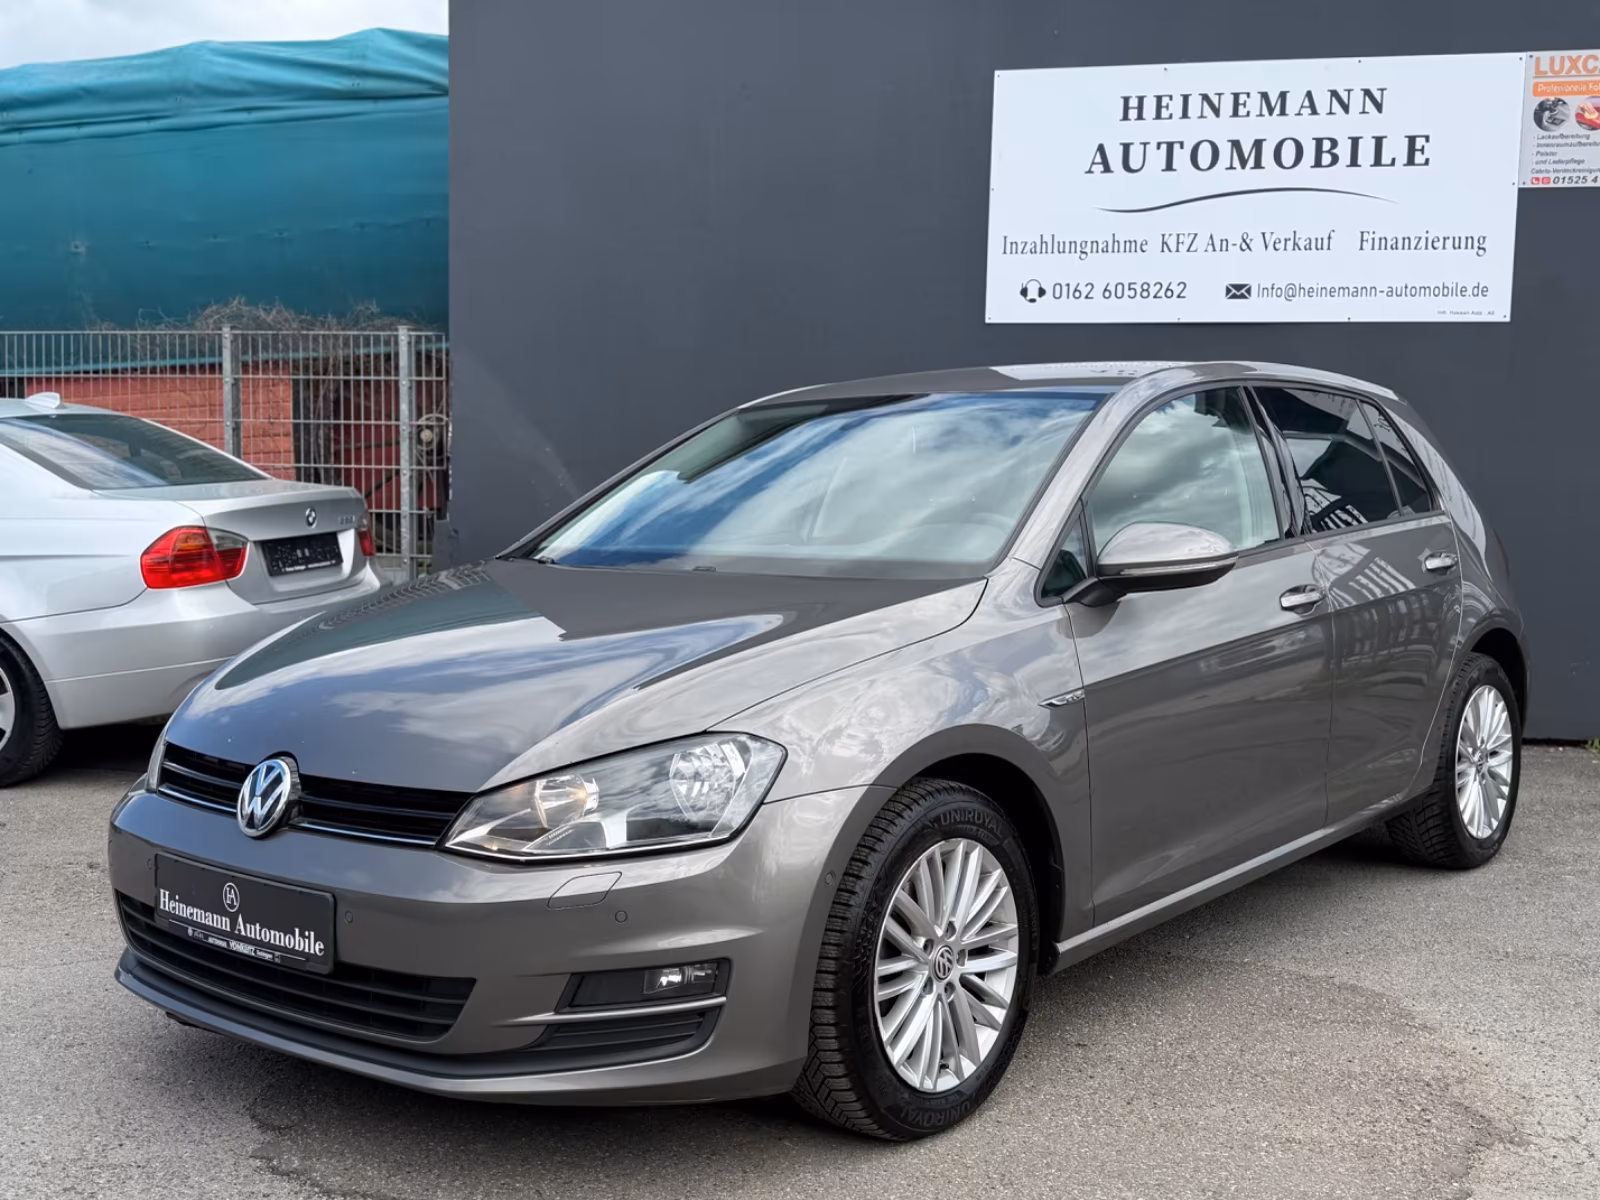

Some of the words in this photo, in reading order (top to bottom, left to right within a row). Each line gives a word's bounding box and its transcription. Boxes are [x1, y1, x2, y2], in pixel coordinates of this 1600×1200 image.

[1534, 55, 1600, 75] LUXC
[1119, 87, 1388, 122] HEINEMANN
[1084, 134, 1431, 174] AUTOMOBILE
[1548, 158, 1586, 166] Lederpflege
[1552, 175, 1588, 185] 01525
[1590, 175, 1599, 184] 4
[1002, 233, 1149, 261] Inzahlungnahme
[1160, 232, 1198, 253] KFZ
[1260, 230, 1335, 252] Verkauf
[1358, 230, 1488, 257] Finanzierung
[1052, 282, 1095, 300] 0162
[1102, 281, 1188, 300] 6058262
[1257, 281, 1489, 302] Info@heinemann-automobile.de
[159, 888, 231, 932] Heinemann
[234, 913, 325, 956] Automobile
